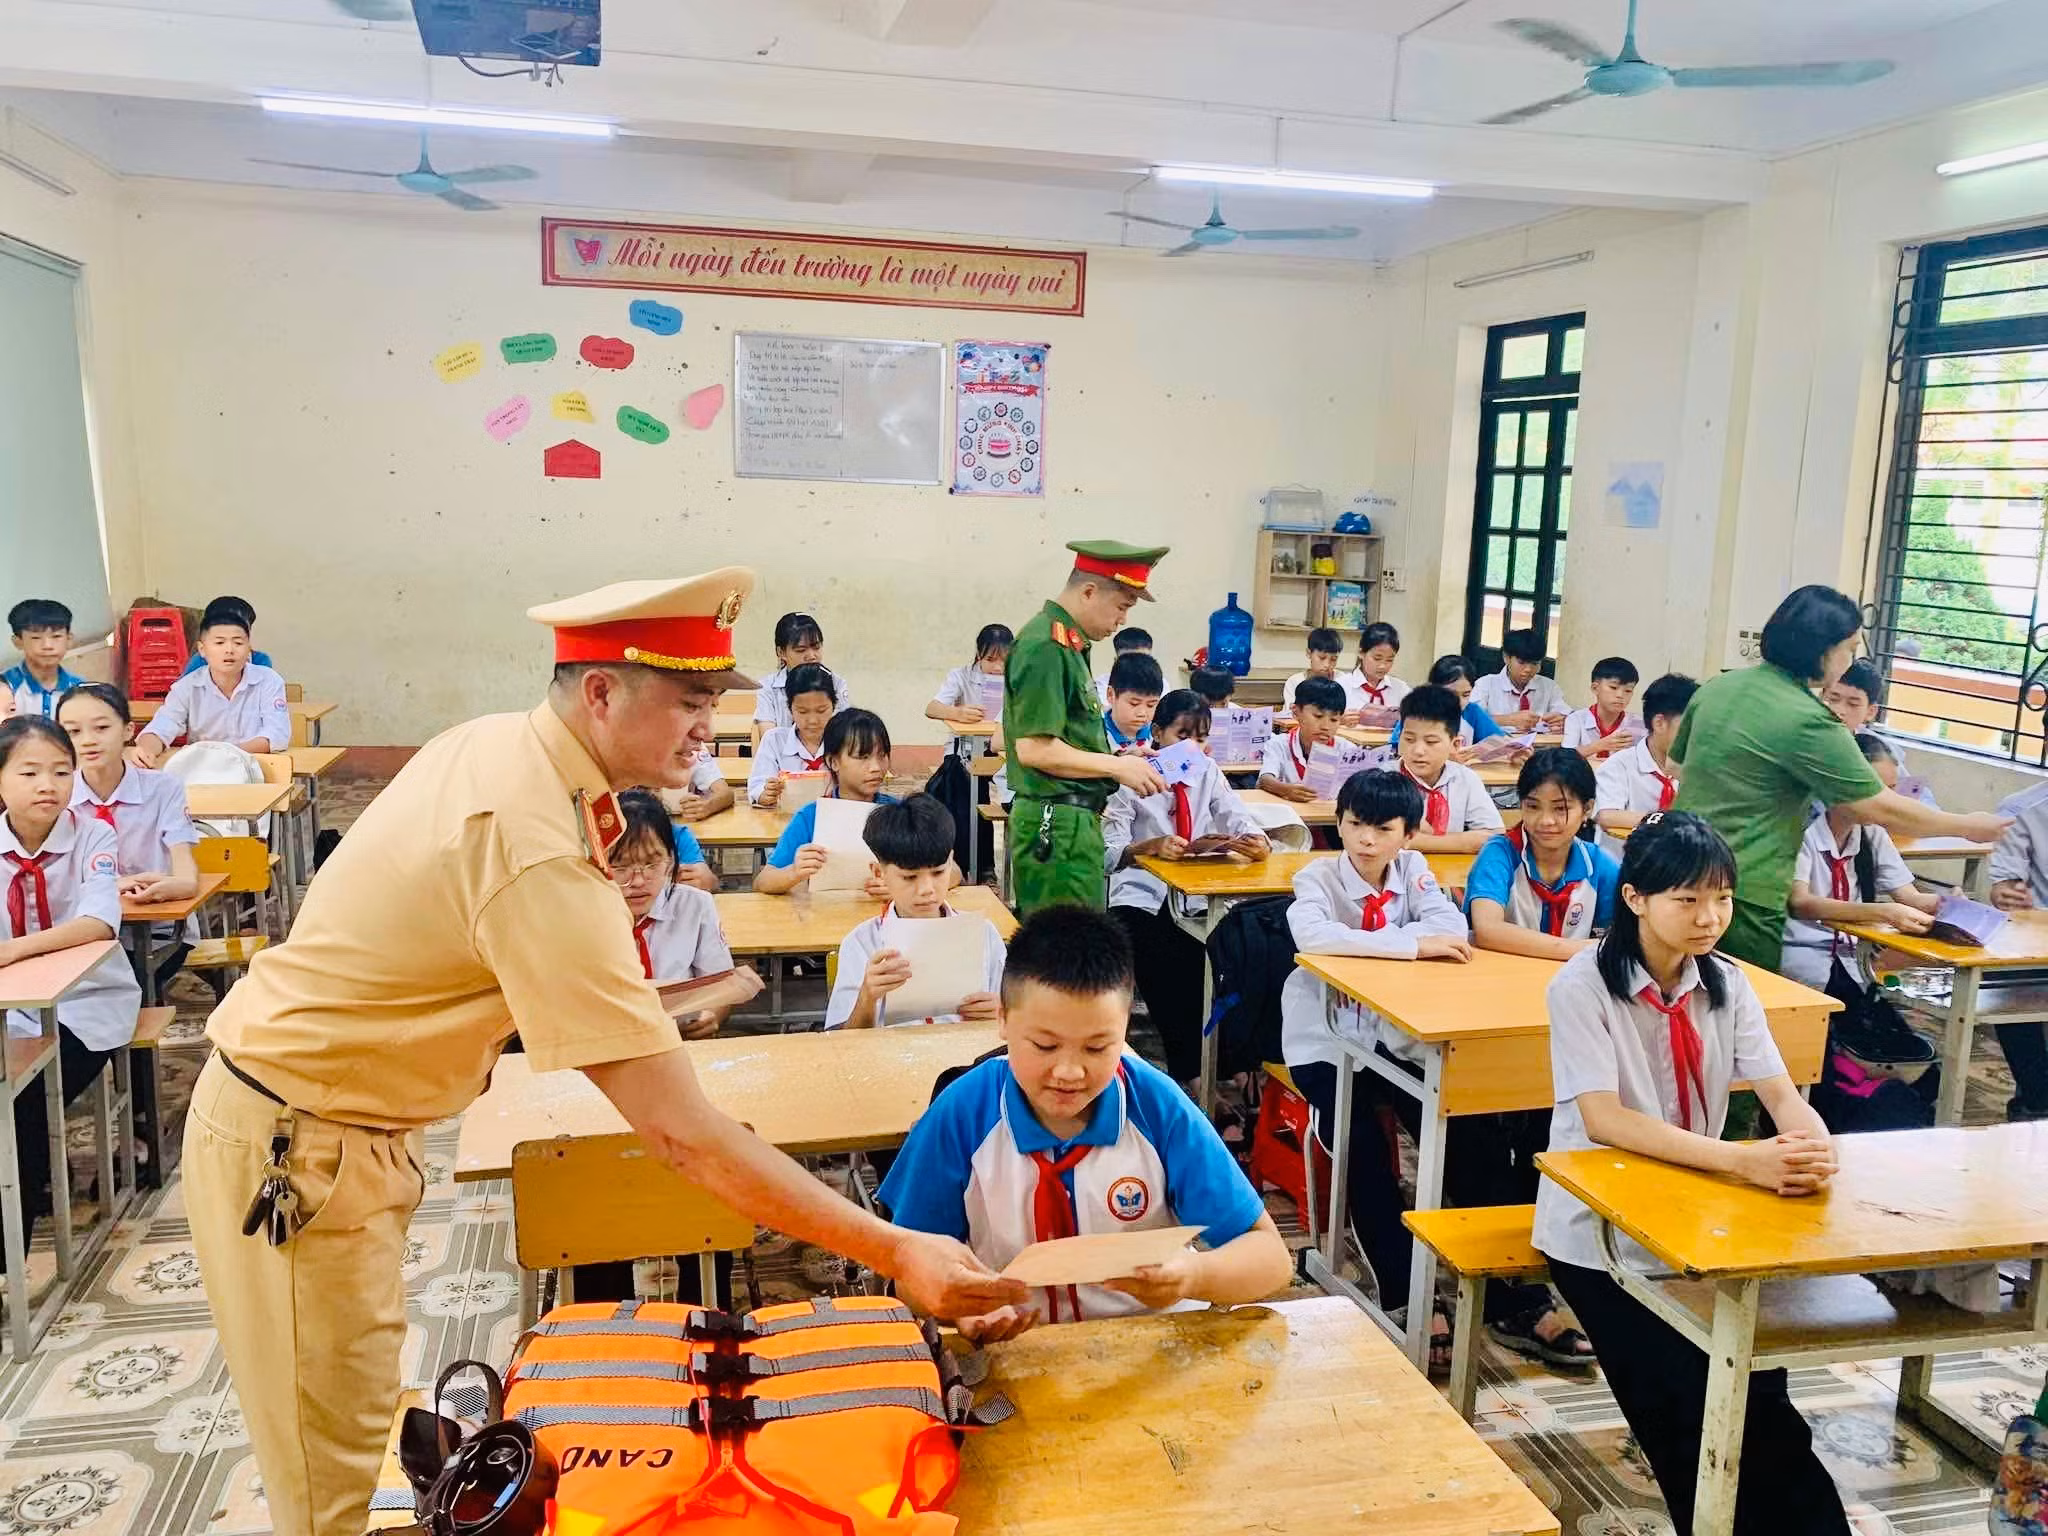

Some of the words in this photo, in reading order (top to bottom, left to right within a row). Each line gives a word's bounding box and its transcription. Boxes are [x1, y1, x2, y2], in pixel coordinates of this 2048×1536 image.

[608, 237, 665, 267] Mỗi
[669, 247, 733, 278] ngày
[741, 246, 787, 275] đến
[794, 253, 873, 288] trường
[879, 255, 903, 284] là
[911, 262, 957, 293] một
[962, 266, 1021, 296] ngày
[1027, 269, 1066, 294] vui
[560, 1446, 673, 1475] CAND
